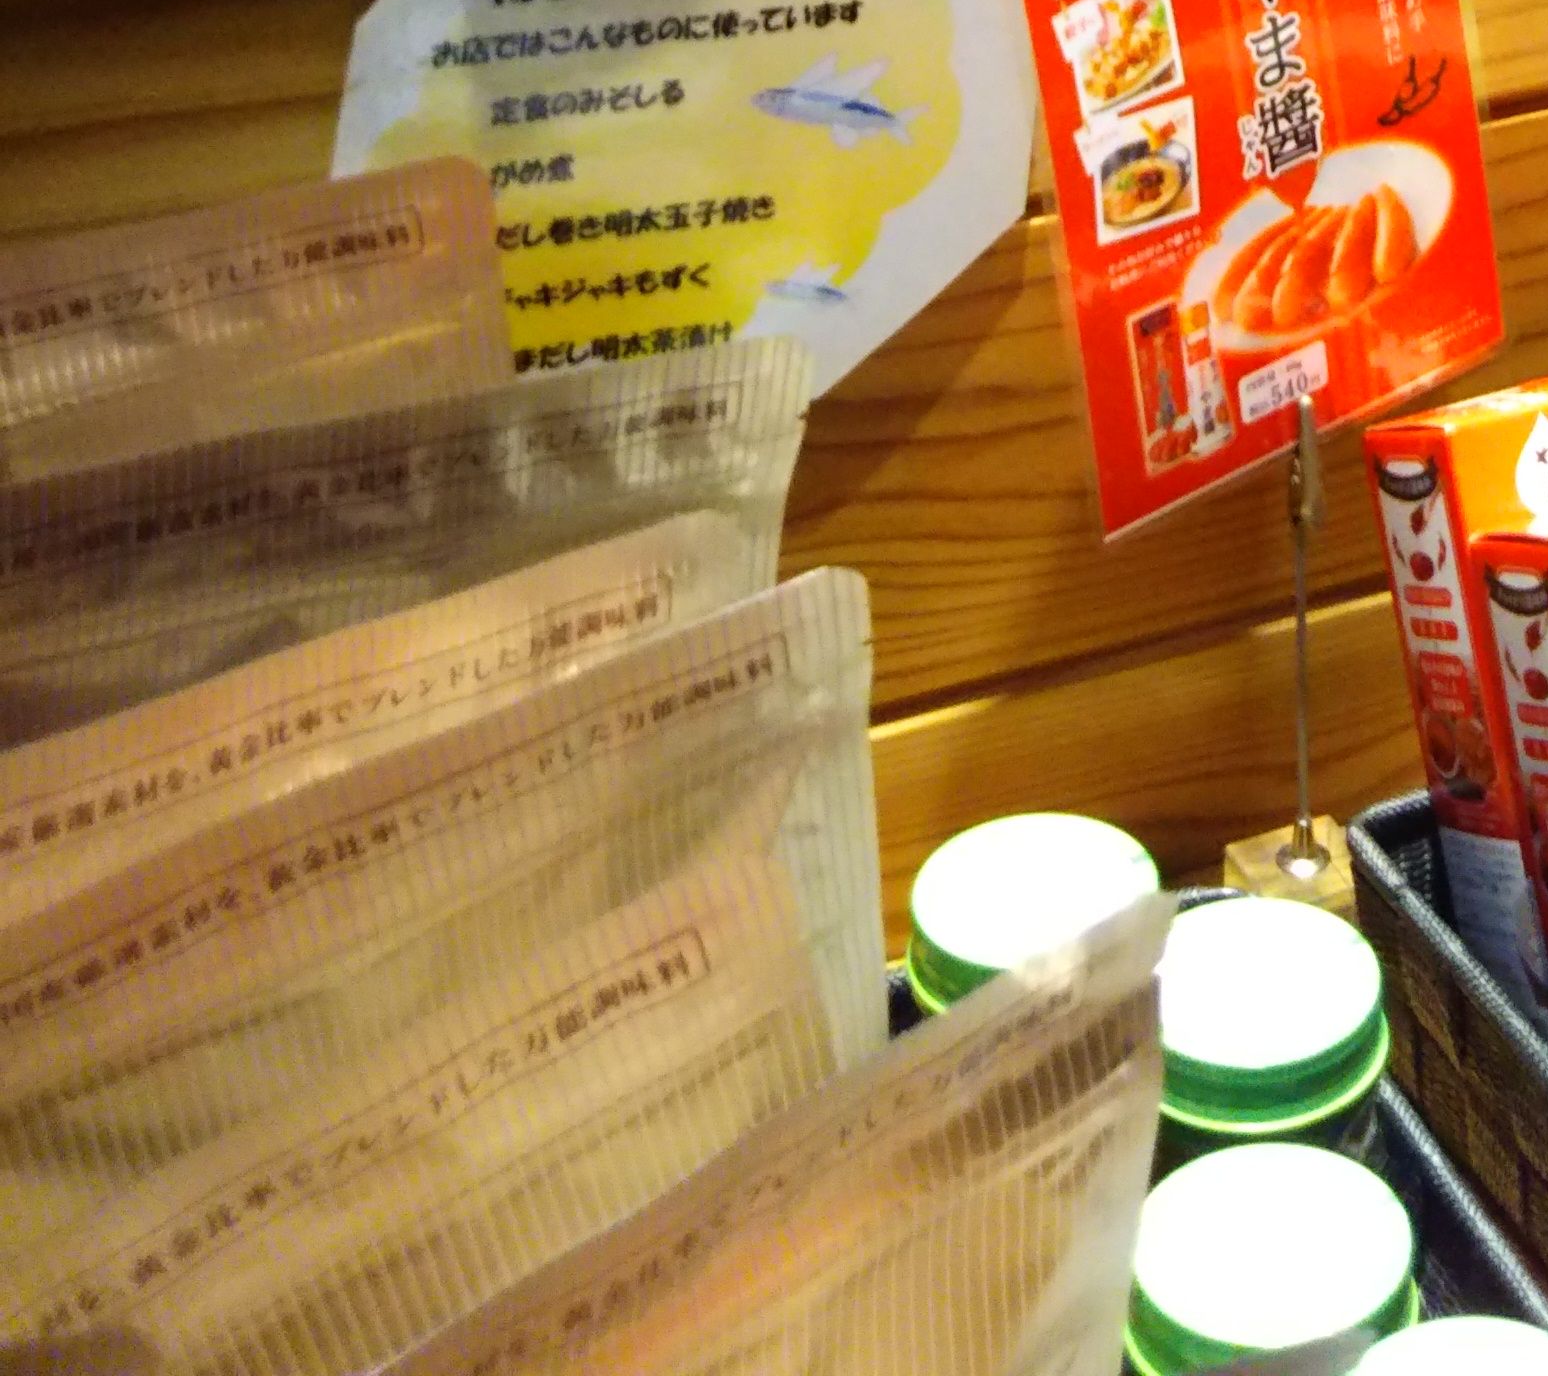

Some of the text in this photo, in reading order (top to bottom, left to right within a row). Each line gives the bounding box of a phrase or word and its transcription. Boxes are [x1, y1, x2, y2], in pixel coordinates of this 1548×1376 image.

[489, 79, 687, 127] 定食のみそしる
[490, 152, 576, 190] がめ煮
